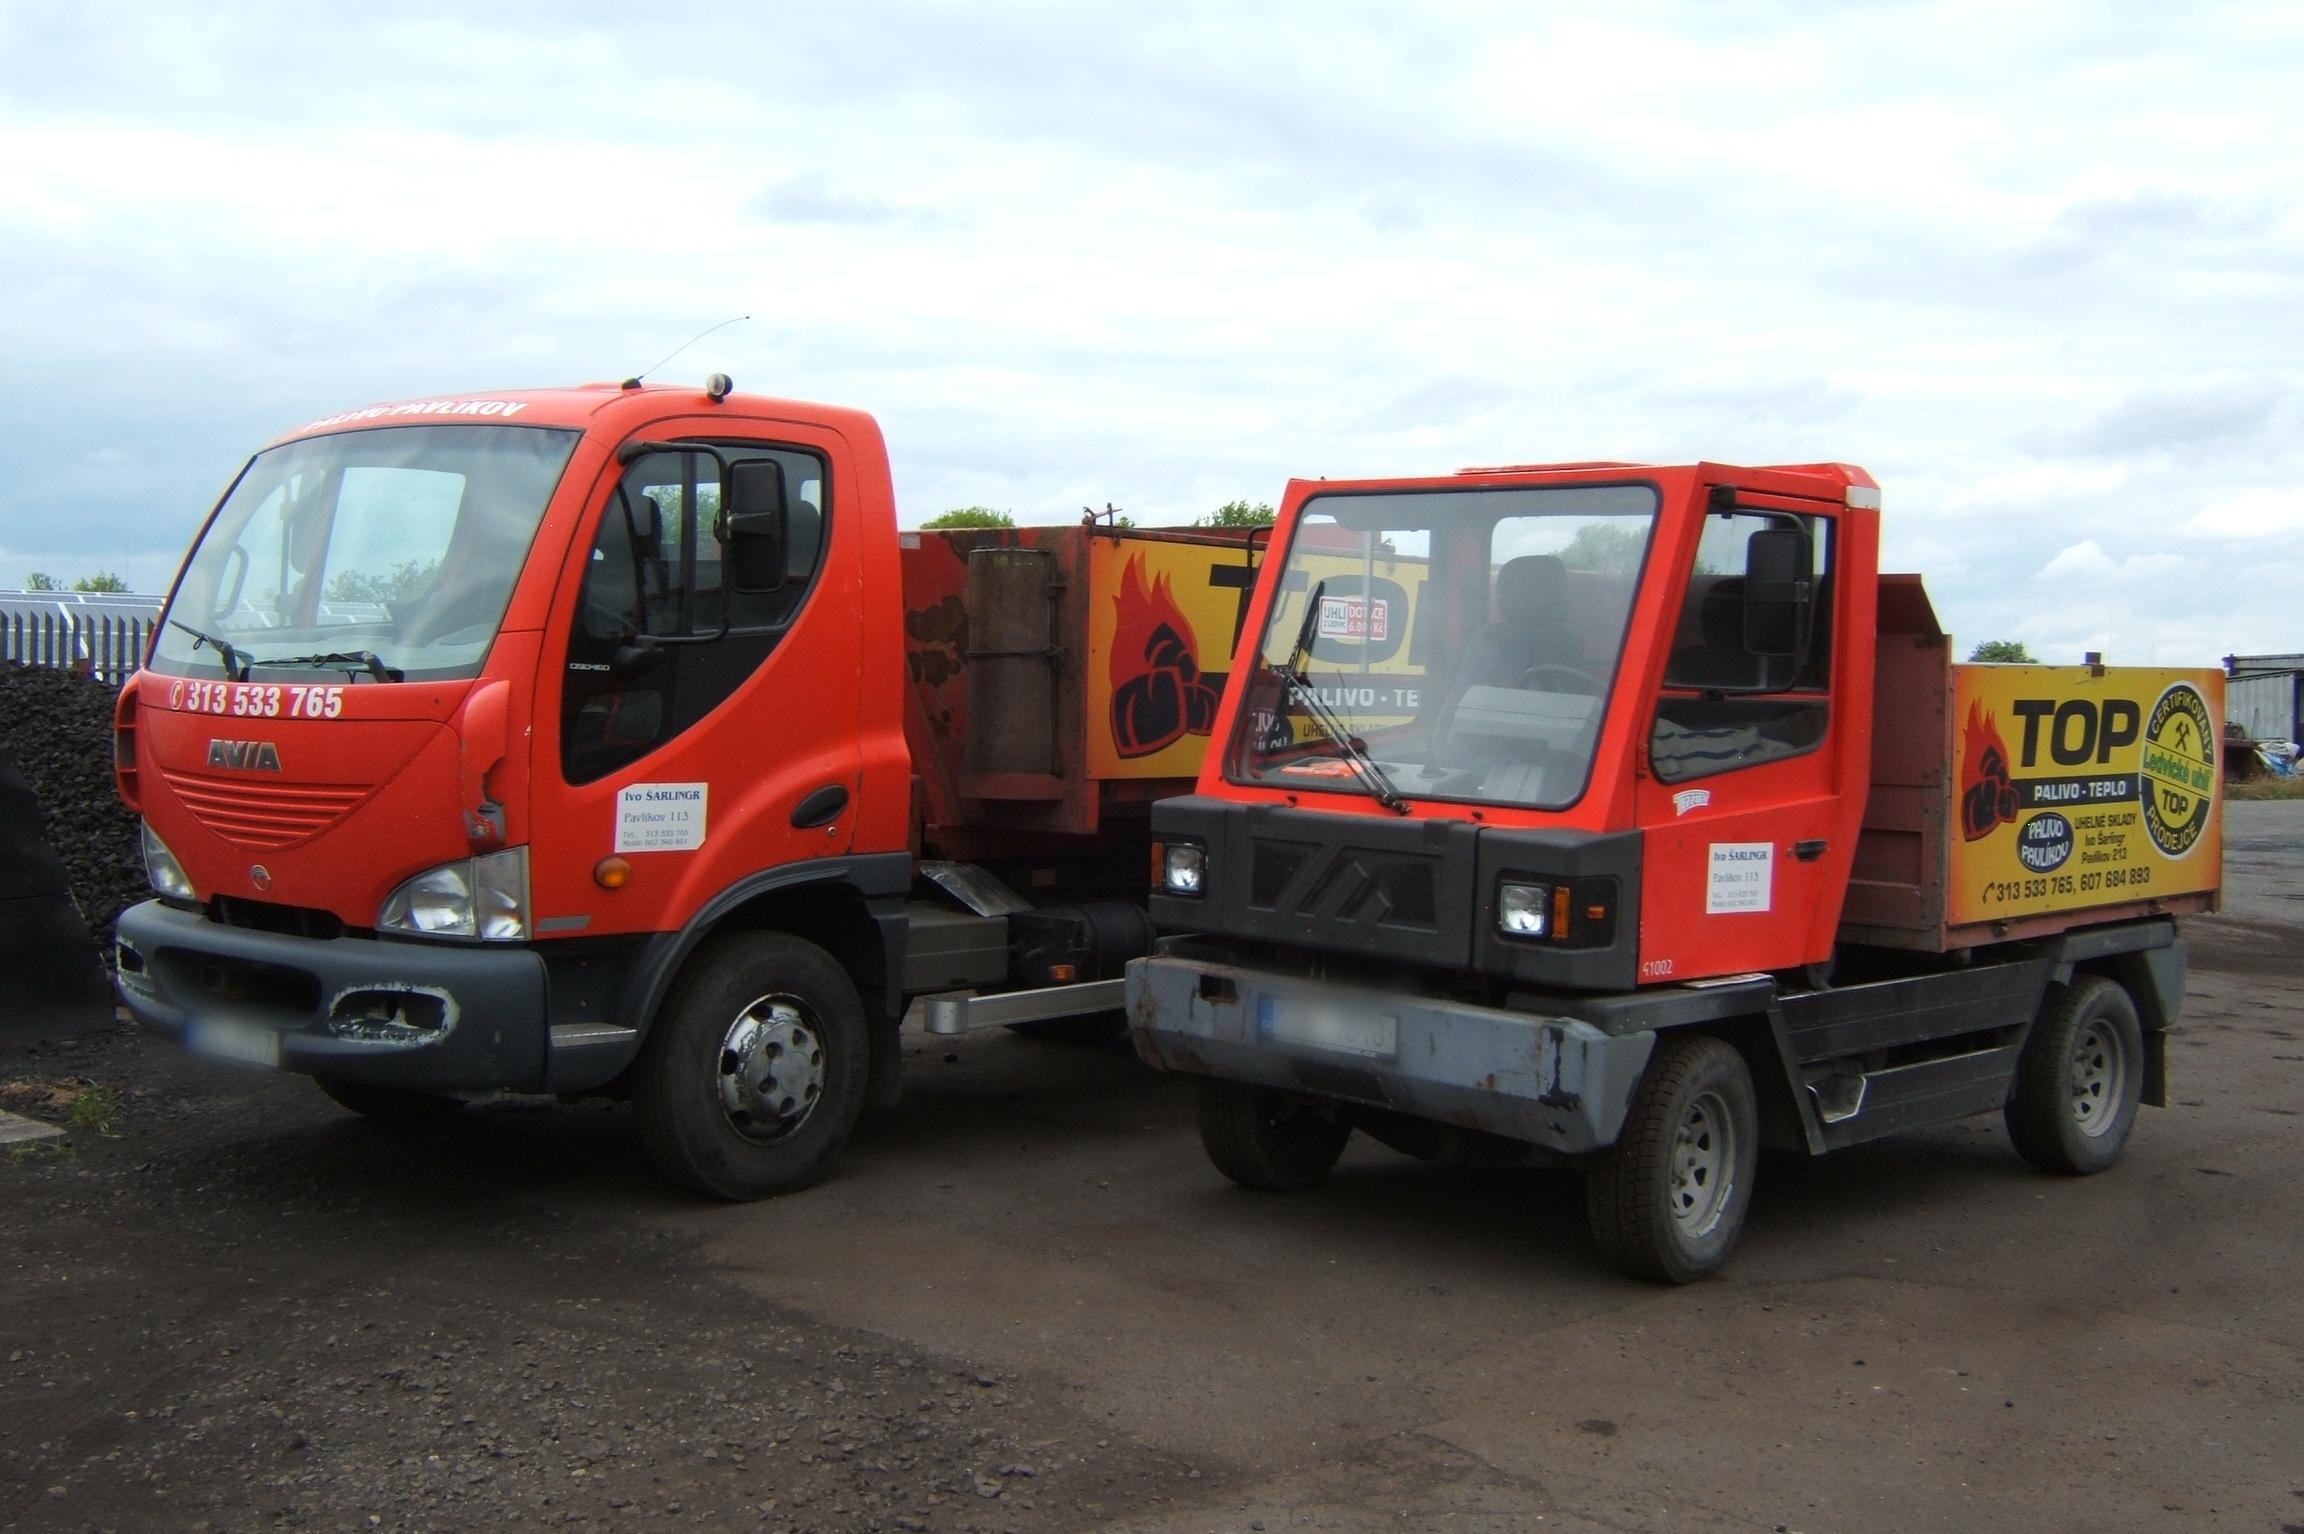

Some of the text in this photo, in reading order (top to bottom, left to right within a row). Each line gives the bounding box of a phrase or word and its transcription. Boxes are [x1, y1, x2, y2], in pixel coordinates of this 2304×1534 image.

[1209, 563, 1429, 666] TO
[188, 681, 344, 718] 313 533 765
[1288, 687, 1375, 707] PALIVO
[2013, 699, 2140, 768] TOP
[206, 738, 283, 773] AVIA
[625, 789, 701, 802] Ivo ŠARLINGR
[2034, 782, 2079, 801] PALIVO
[2088, 780, 2126, 798] TEPLO
[2162, 788, 2189, 816] TOP
[2028, 818, 2064, 840] PALIVO
[2074, 812, 2137, 830] UHELNÉ SKLADY
[2146, 806, 2198, 851] PRODEJCE
[2112, 848, 2127, 861] 213
[1996, 867, 2150, 901] 313 533 765, 607 684 893
